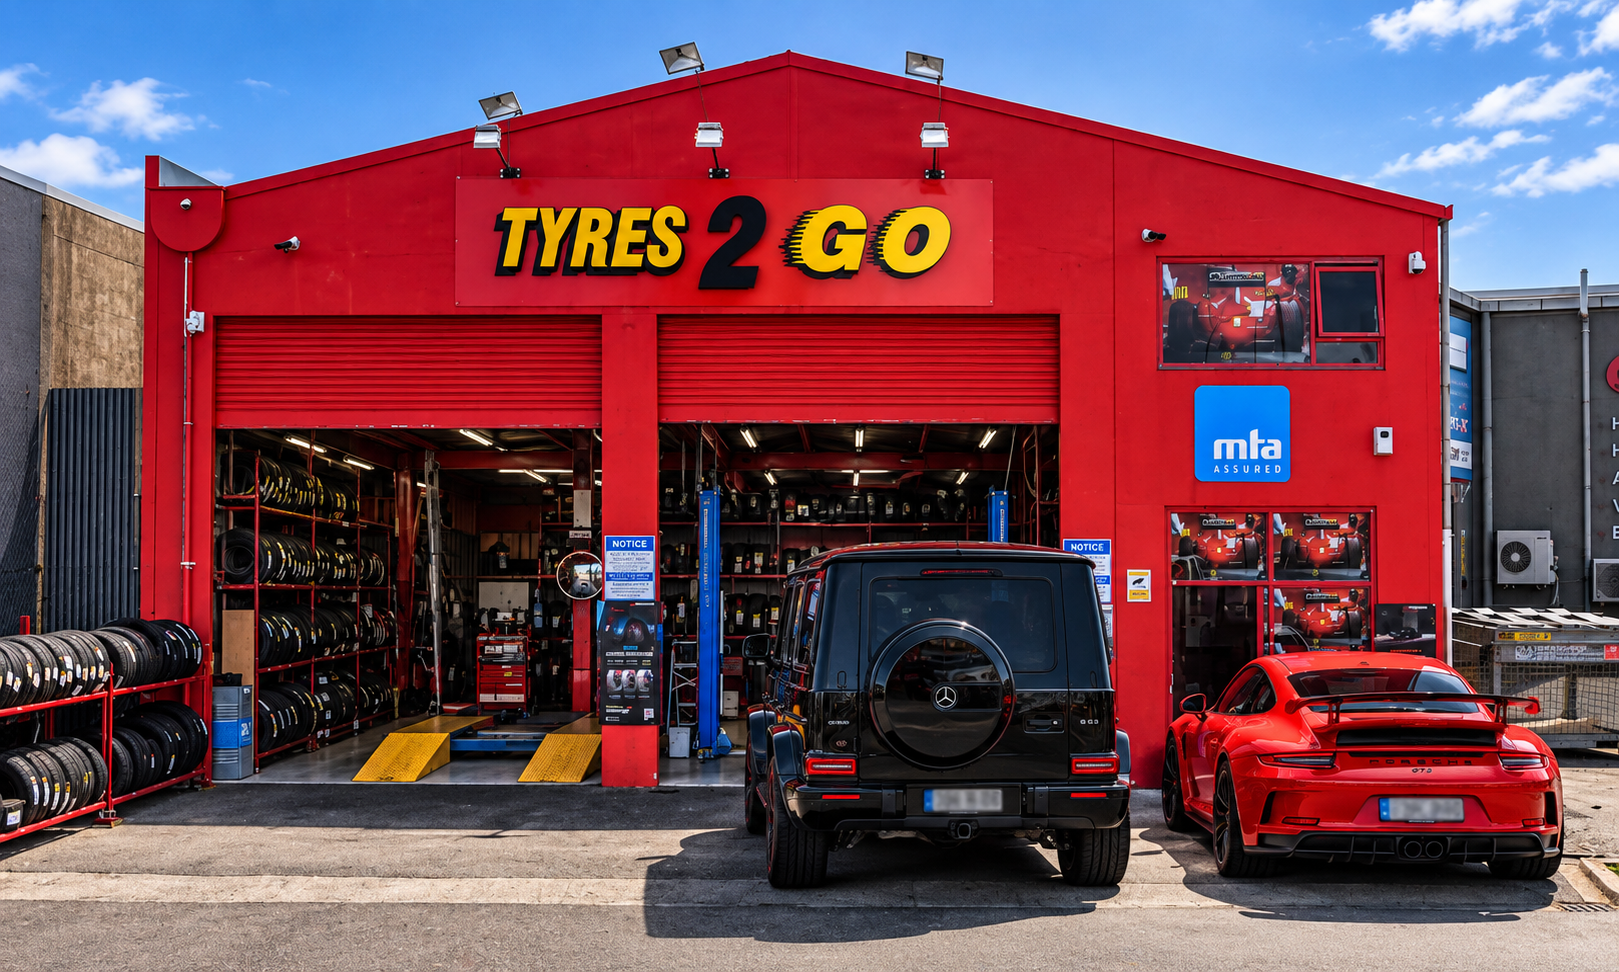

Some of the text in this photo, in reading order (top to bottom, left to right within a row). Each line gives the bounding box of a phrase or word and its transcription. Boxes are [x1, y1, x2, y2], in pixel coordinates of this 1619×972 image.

[494, 195, 951, 290] TYRES 2 GO
[1213, 428, 1282, 460] mta
[1213, 464, 1282, 474] ASSURED
[612, 540, 648, 548] NOTICE
[1070, 543, 1104, 552] NOTICE
